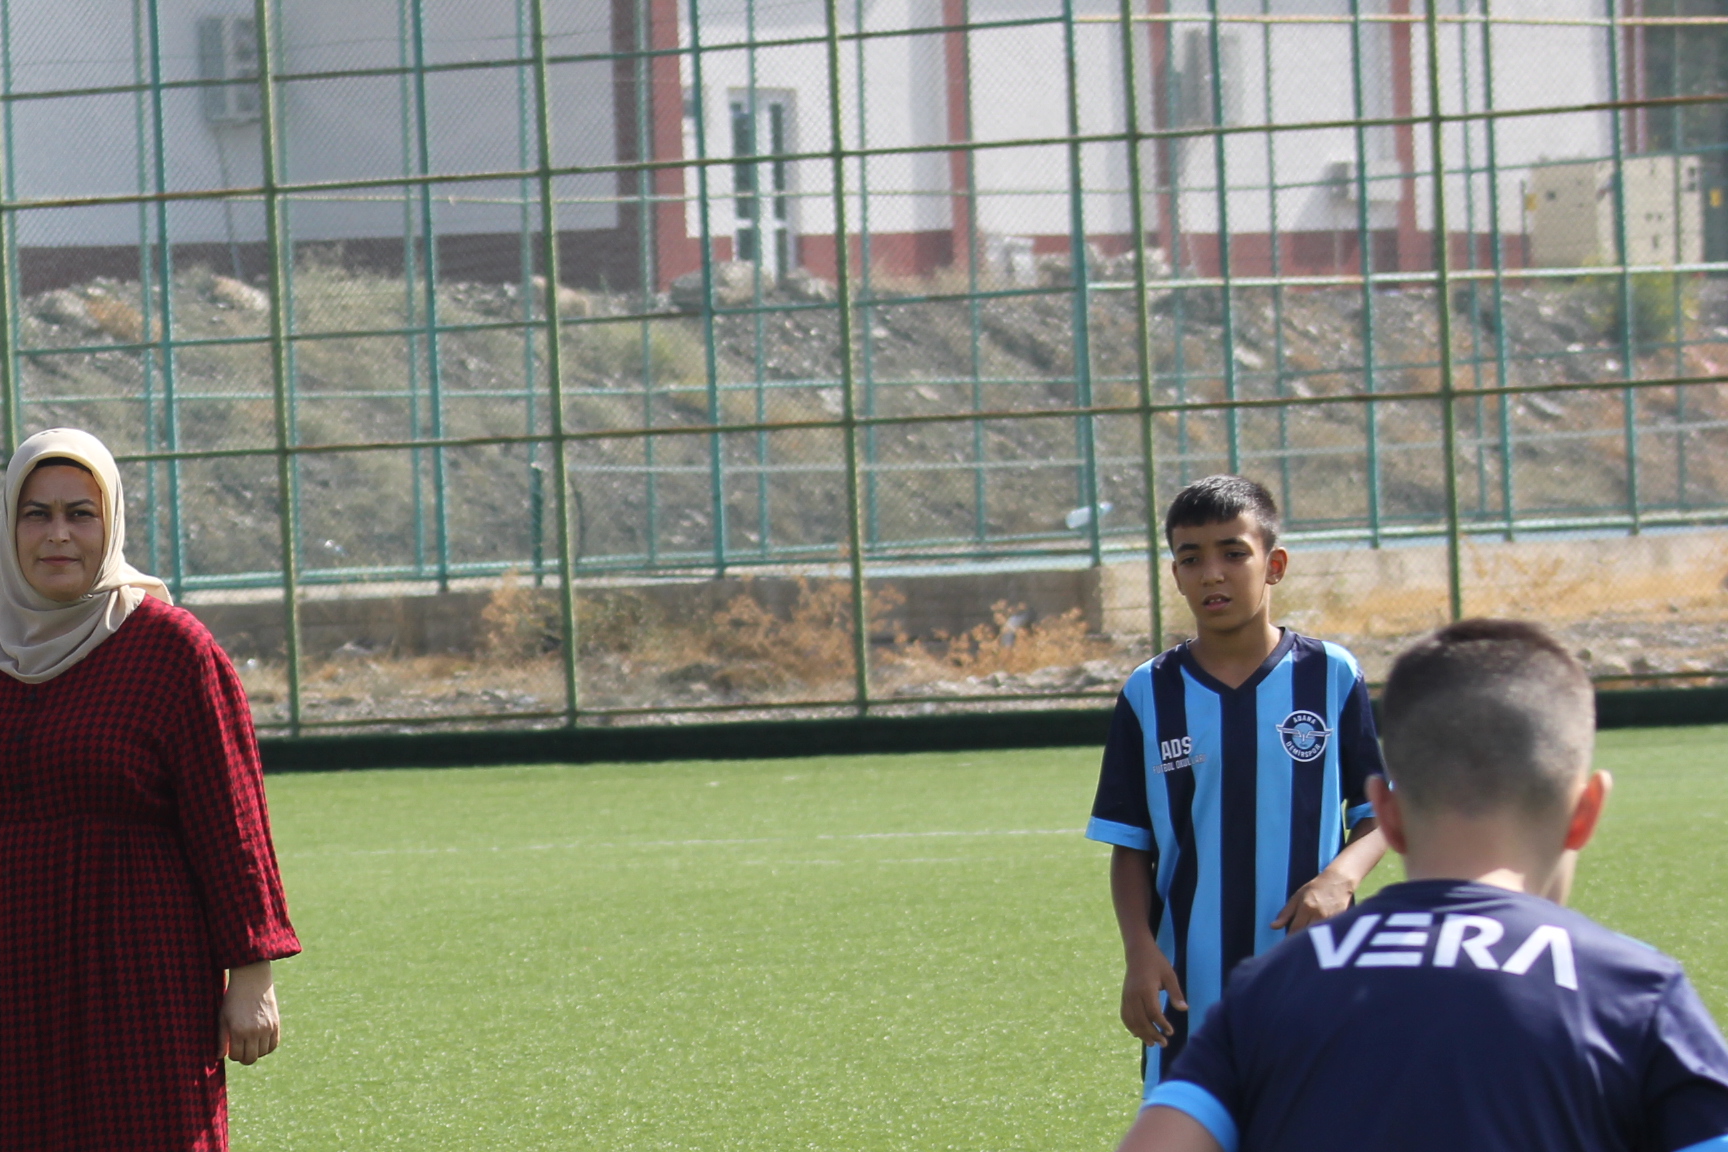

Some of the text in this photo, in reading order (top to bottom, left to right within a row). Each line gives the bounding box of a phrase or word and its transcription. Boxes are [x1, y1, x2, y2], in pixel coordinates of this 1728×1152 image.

[1293, 715, 1316, 724] ADANA
[1161, 736, 1192, 760] ADS
[1309, 913, 1579, 991] VERA
